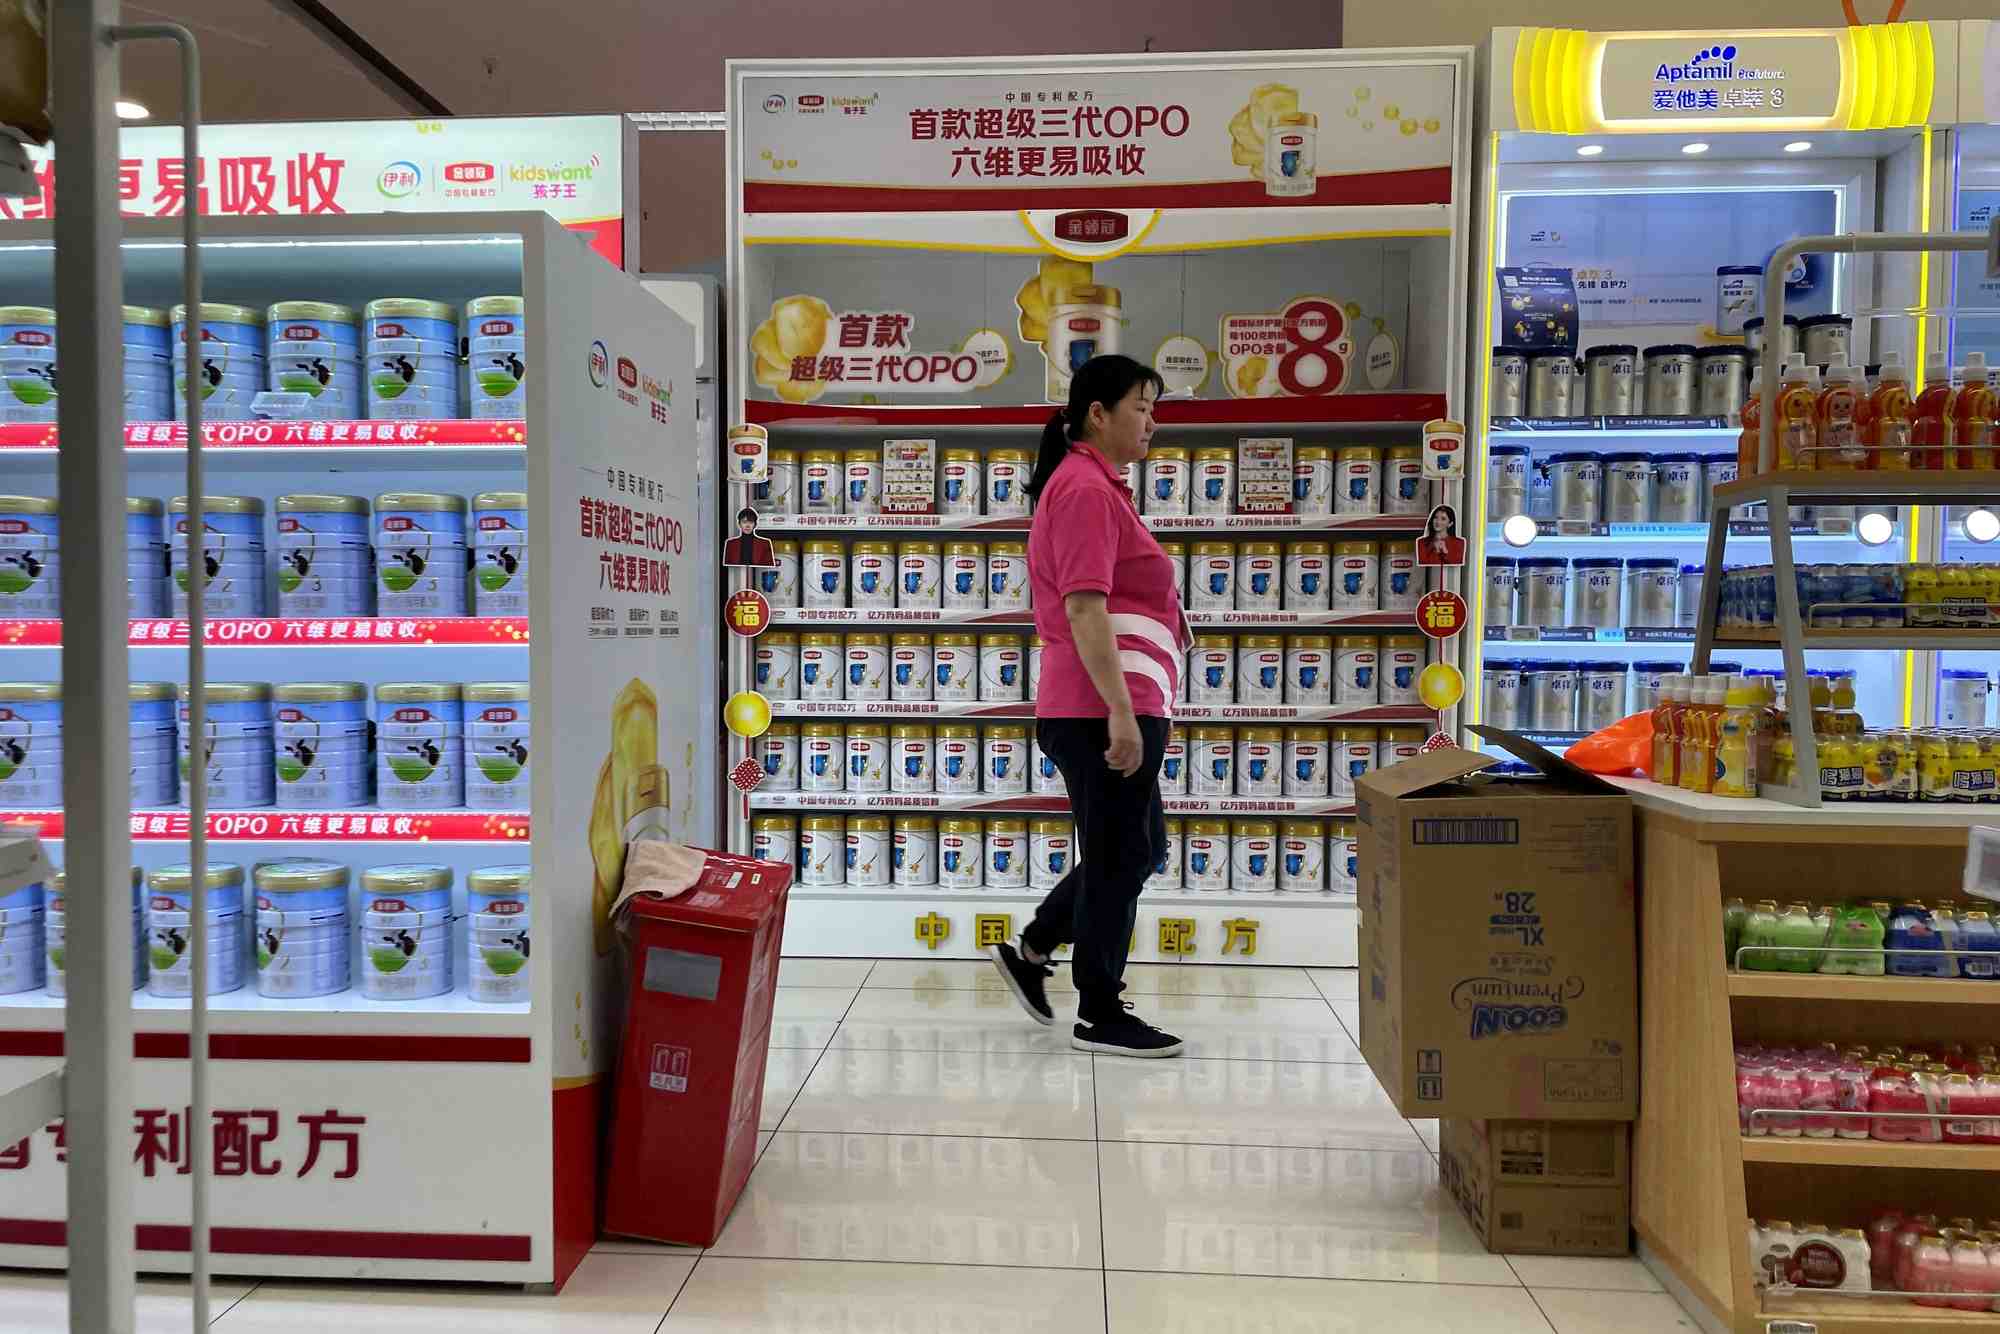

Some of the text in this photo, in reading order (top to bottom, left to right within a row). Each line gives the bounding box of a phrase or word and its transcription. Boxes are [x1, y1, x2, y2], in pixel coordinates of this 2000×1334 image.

[1655, 62, 1733, 83] Aptamil
[1005, 91, 1095, 103] 中国专利配方
[1654, 88, 1718, 109] 爱他美
[1769, 87, 1785, 108] 3
[909, 104, 1190, 140] 首款超级三代OPO
[951, 143, 1146, 178] 六维更易吸收
[383, 170, 415, 188] 伊利
[510, 162, 592, 182] kidswant
[533, 183, 577, 199] 孩子王
[839, 313, 910, 349] 首款
[1277, 300, 1345, 397] 8
[1338, 342, 1349, 354] g
[788, 354, 978, 384] 超级三代OPO
[285, 423, 419, 442] 六维更易吸收
[579, 495, 683, 554] 首款超级三代OPO
[600, 551, 671, 595] 六维更易吸收
[733, 602, 760, 626] 福
[1425, 601, 1456, 629] 福
[284, 621, 418, 639] 六维更易吸收
[280, 816, 414, 835] 六维更易吸收
[1504, 891, 1536, 914] 28
[1516, 927, 1545, 946] XL
[1470, 981, 1563, 1004] Premium
